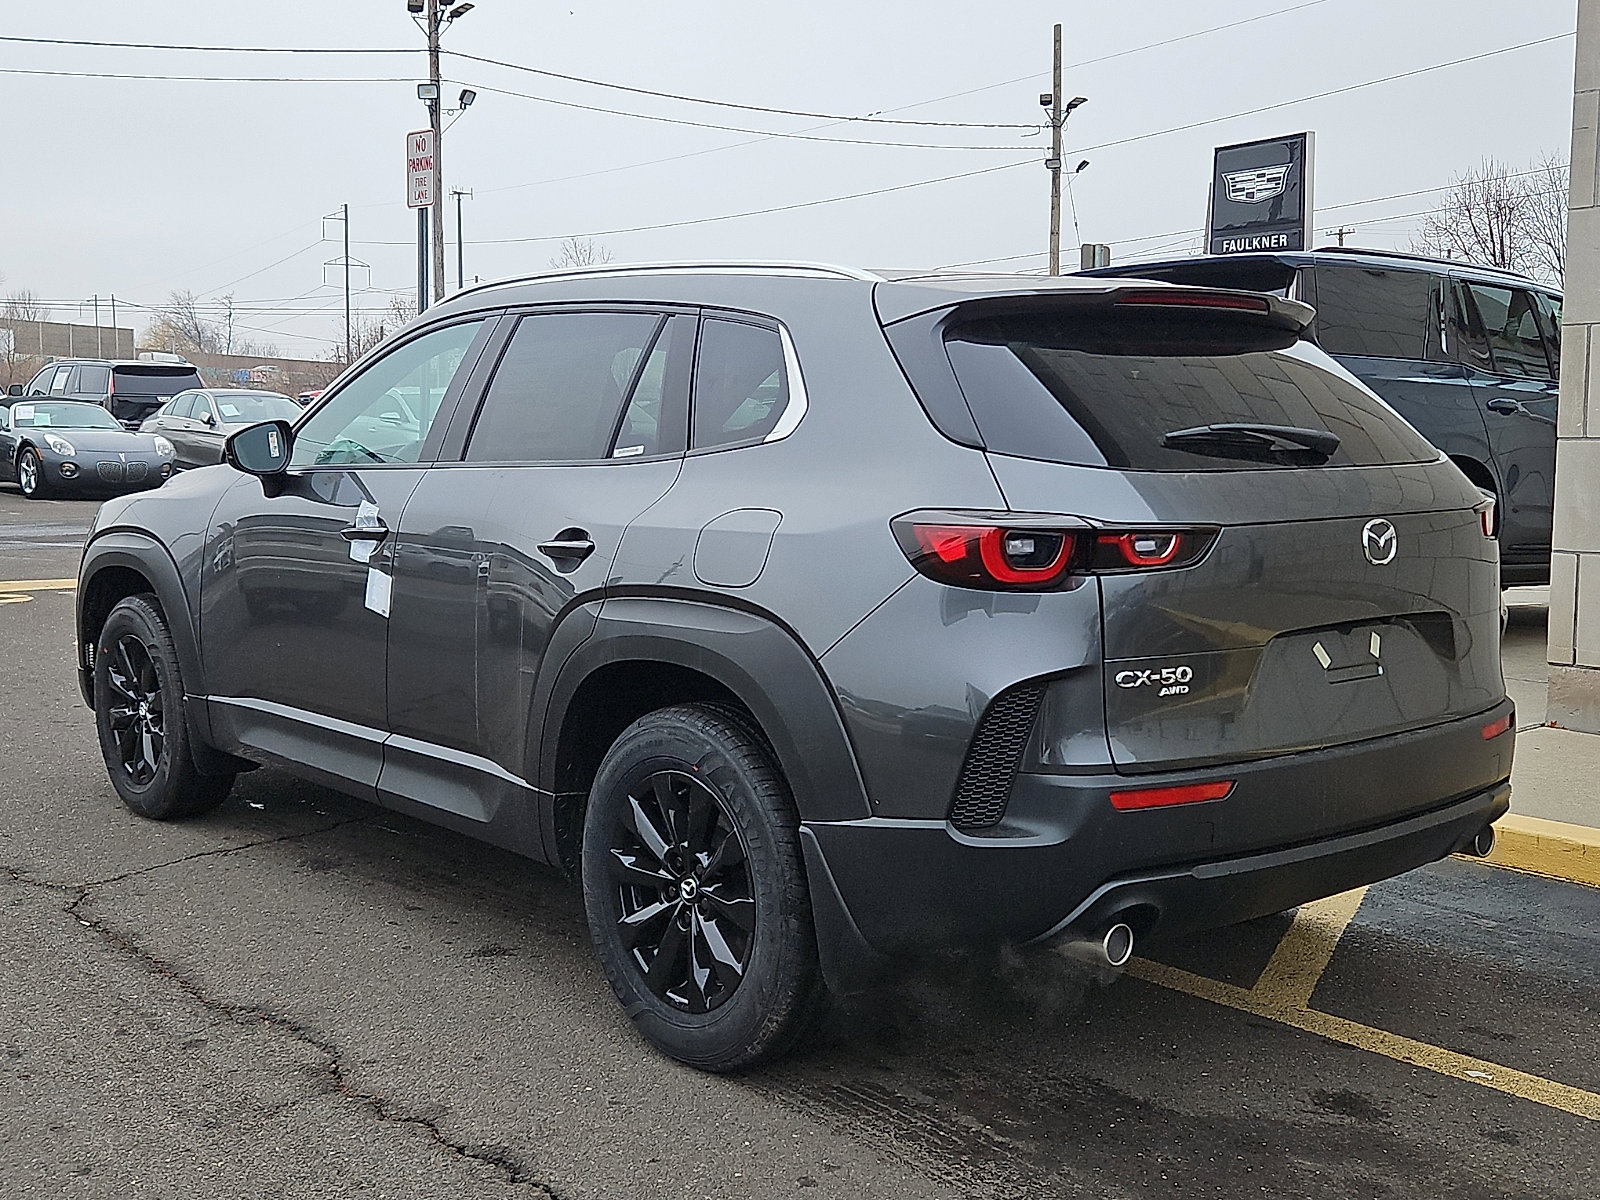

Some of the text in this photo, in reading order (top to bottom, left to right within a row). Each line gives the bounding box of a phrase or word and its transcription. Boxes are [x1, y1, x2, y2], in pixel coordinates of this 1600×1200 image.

[415, 138, 427, 153] NO
[409, 155, 432, 173] PARKING
[415, 177, 427, 187] FIRE
[414, 190, 428, 201] LANE
[1222, 234, 1288, 253] FAULKNER
[1115, 666, 1193, 688] CX-50
[1158, 685, 1190, 697] AWD
